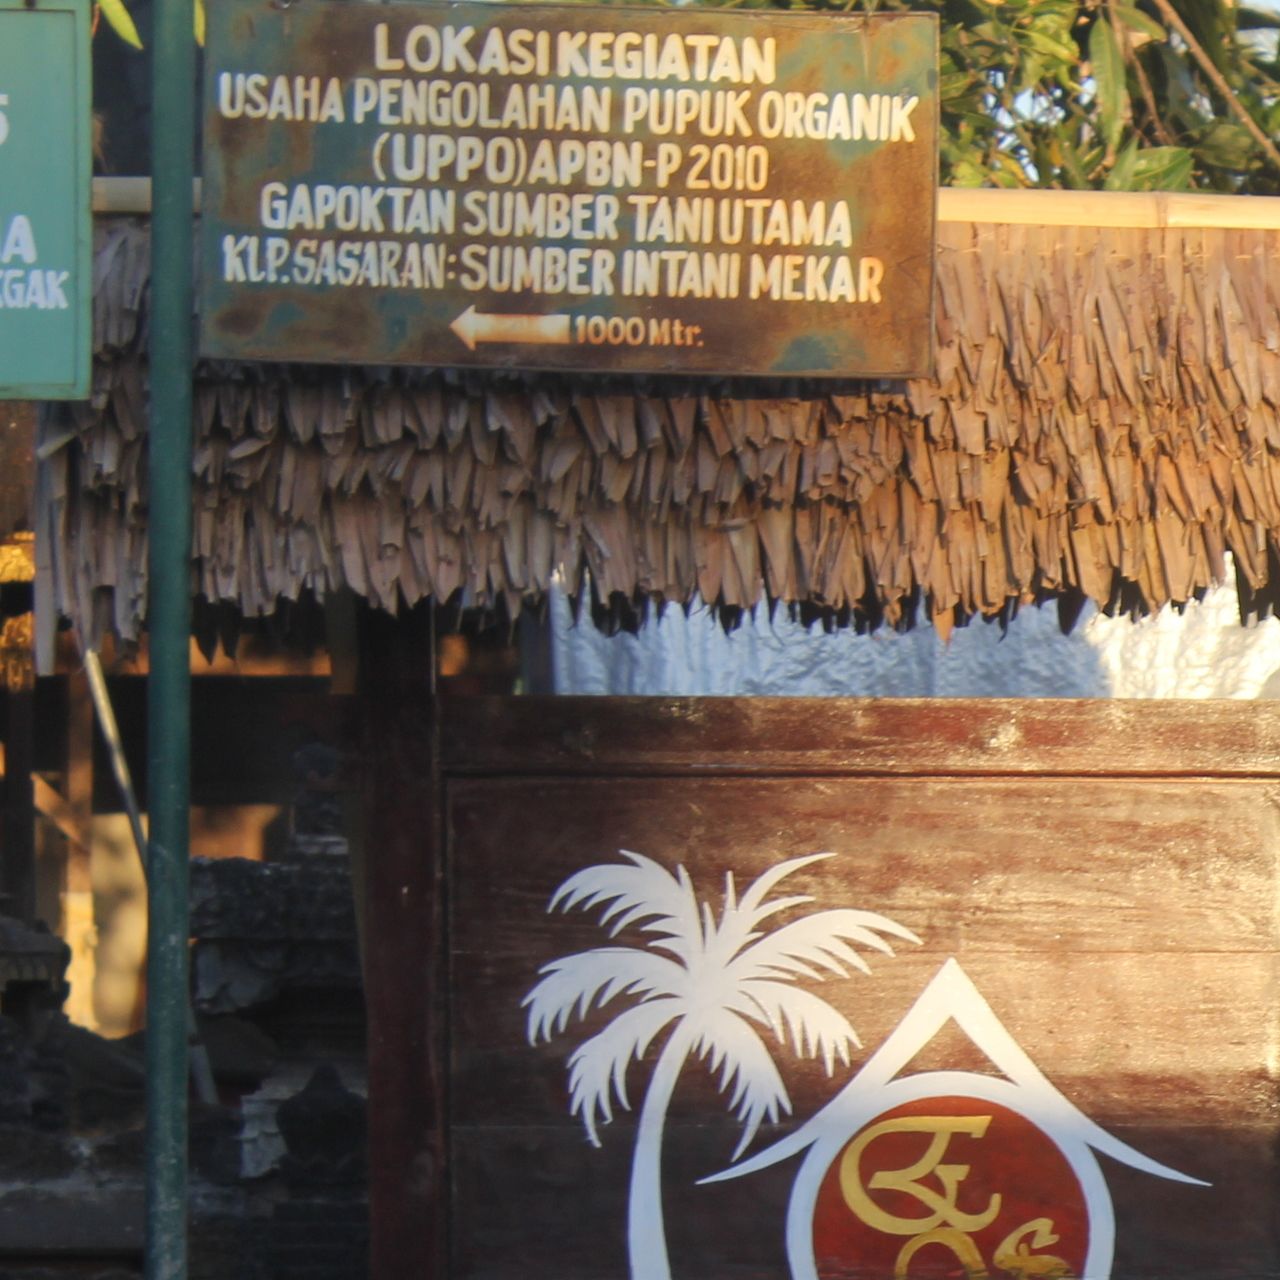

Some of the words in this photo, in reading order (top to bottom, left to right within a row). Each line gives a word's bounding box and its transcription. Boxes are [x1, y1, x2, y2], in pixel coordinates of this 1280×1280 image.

[374, 22, 550, 77] LOKASI
[556, 31, 776, 84] KEGIATAN
[218, 72, 345, 123] USAHA
[353, 78, 612, 134] PENGOLAHAN
[623, 87, 752, 138] PUPUK
[758, 92, 919, 142] ORGANIK
[685, 143, 769, 191] 2010
[260, 182, 455, 234] GAPOKTAN
[462, 190, 620, 240] SUMBER
[627, 195, 715, 244] TANI
[719, 198, 852, 248] UTAMA
[0, 269, 70, 309] GAK
[460, 244, 616, 296] SUMBER
[621, 249, 741, 299] INTANI
[749, 253, 884, 304] MEKAR
[575, 315, 646, 345] 1000
[649, 318, 704, 347] Mtr.
